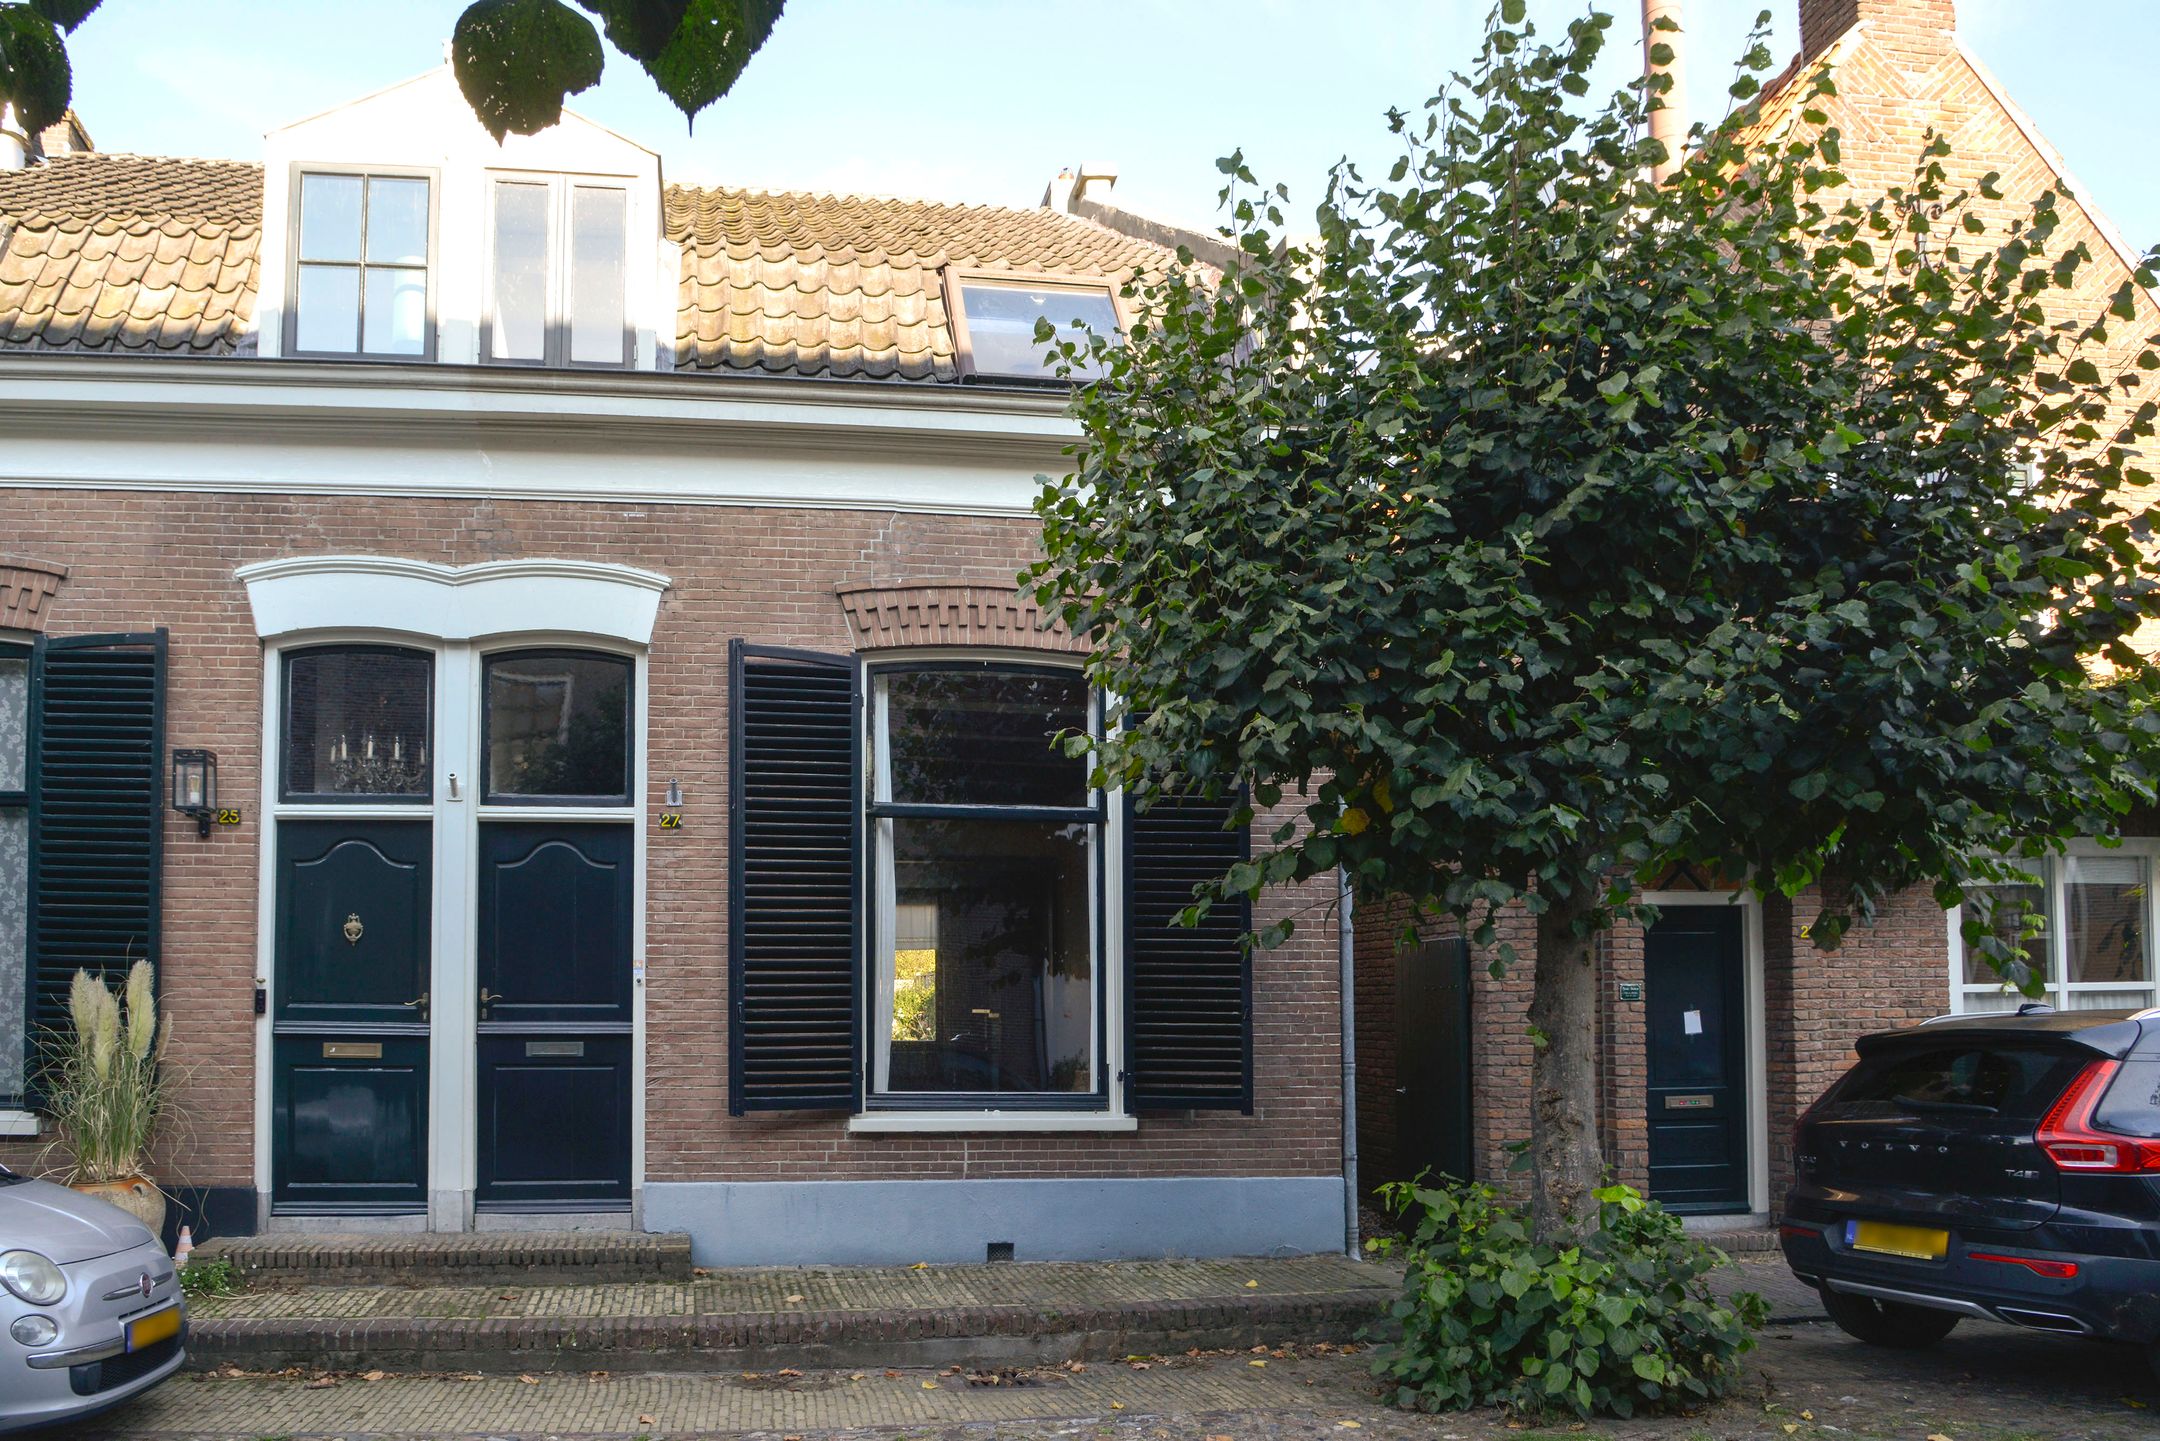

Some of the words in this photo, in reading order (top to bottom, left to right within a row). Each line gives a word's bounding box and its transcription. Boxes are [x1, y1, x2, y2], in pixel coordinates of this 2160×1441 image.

[219, 809, 240, 824] 25
[661, 813, 680, 827] 27
[1839, 1140, 1948, 1153] VOLVO
